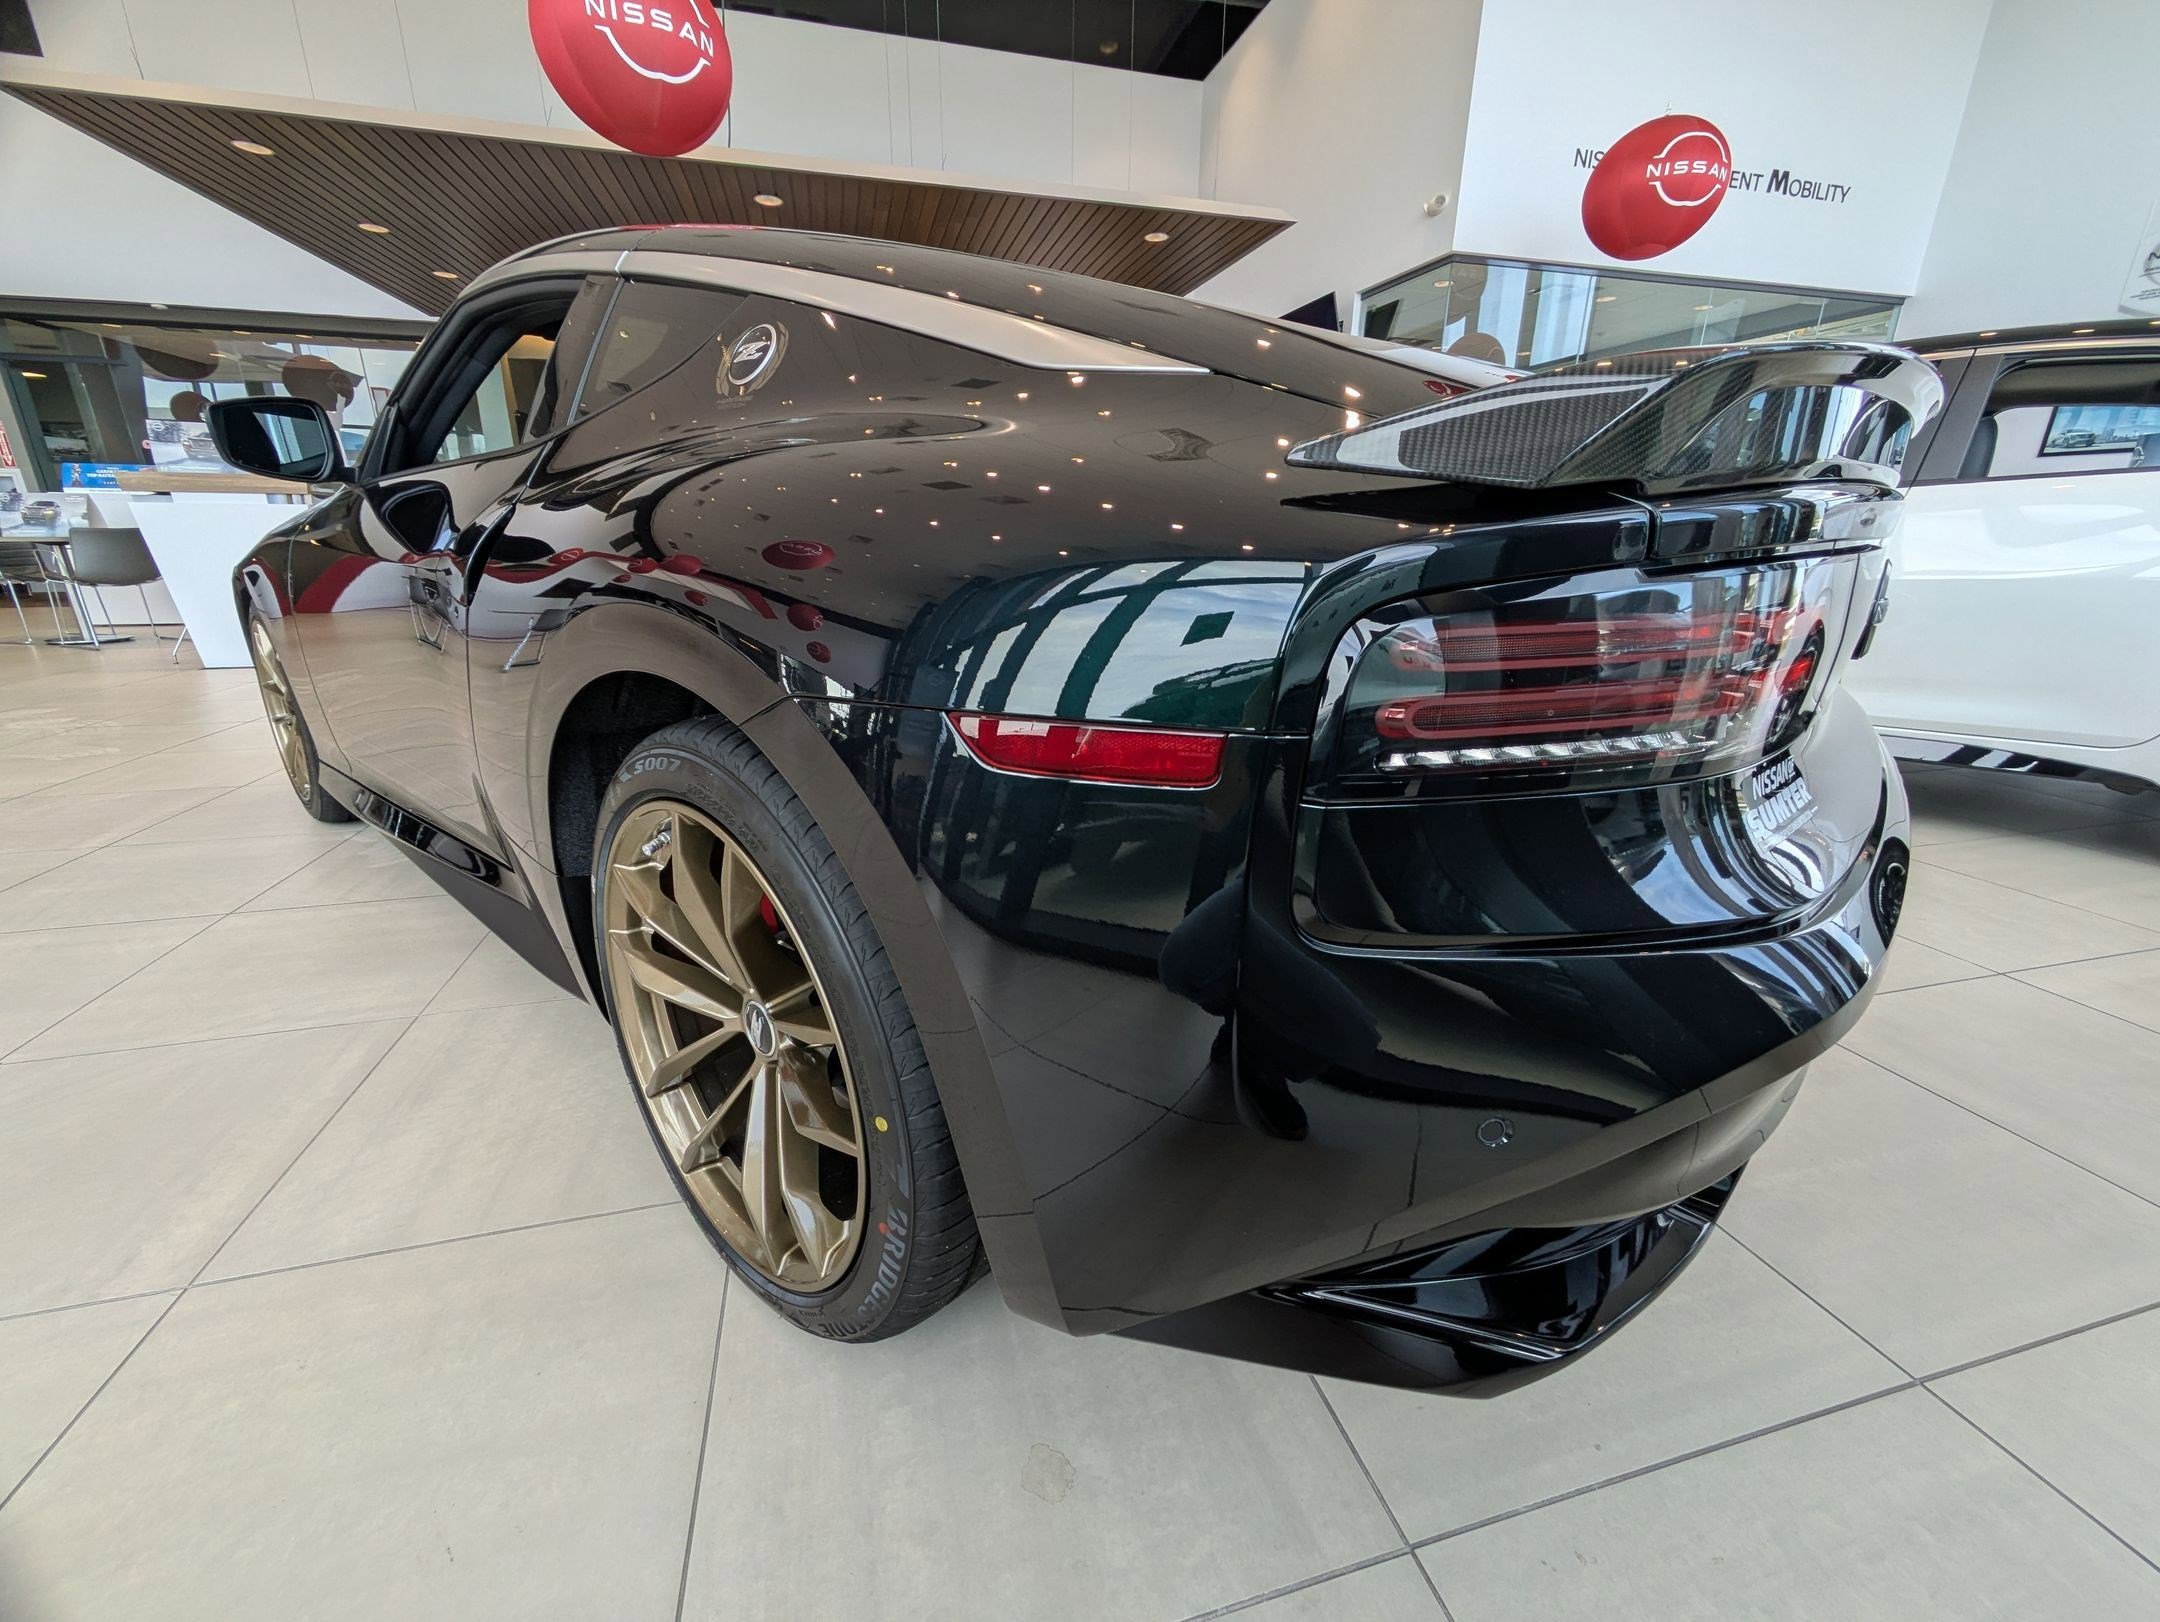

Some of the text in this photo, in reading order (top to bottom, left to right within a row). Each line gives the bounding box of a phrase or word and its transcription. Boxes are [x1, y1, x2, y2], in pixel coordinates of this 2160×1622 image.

[584, 0, 715, 58] NISSAN
[1646, 160, 1728, 183] NISSAN
[1766, 168, 1852, 204] MOBILITY
[1752, 758, 1789, 801] NISSAN
[1746, 776, 1812, 838] SUMTER
